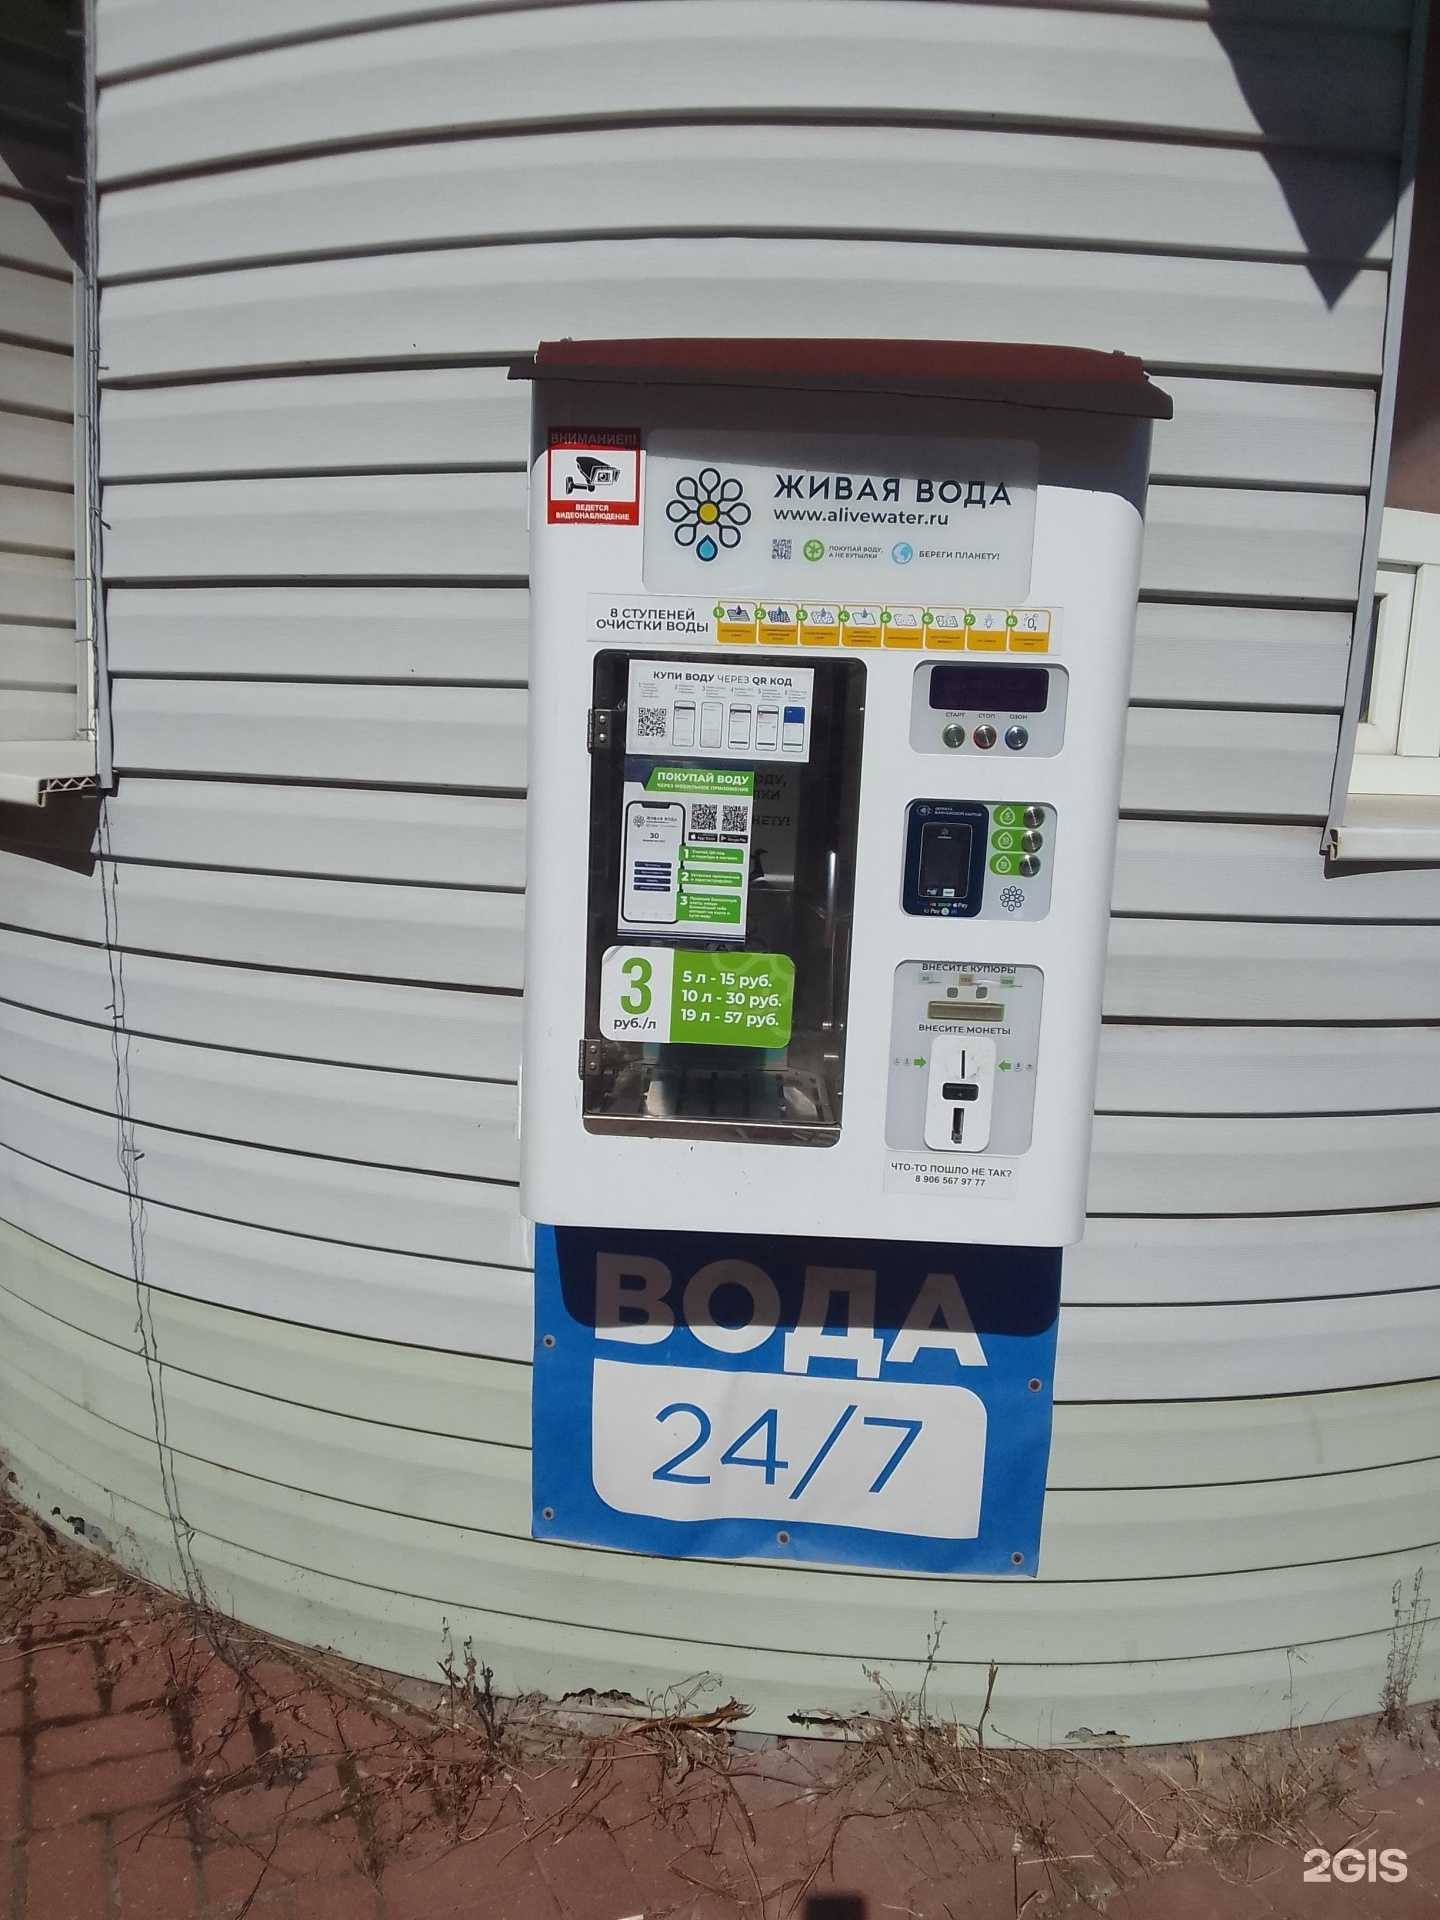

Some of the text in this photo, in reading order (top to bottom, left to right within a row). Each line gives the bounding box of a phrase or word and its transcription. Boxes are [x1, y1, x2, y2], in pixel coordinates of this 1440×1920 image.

[551, 432, 636, 445] ВНИМАНИЕ!!!
[773, 474, 1012, 508] ЖИВАЯ ВОДА
[575, 504, 609, 512] ВЕДЕТСЯ
[556, 512, 629, 520] ВИДЕОНАБЛЮДЕНИЕ
[773, 507, 949, 525] www.alivewater.ru
[829, 545, 862, 553] ПОКУПАЙ
[919, 550, 1000, 560] БЕРЕГИ ПЛАНЕТУ!
[610, 607, 695, 621] 8 СТУПЕНЕЙ
[596, 619, 662, 631] ОЧИСТКИ
[666, 621, 709, 634] ВОДЫ
[653, 671, 792, 687] КУПИ ВОДУ ЧЕРЕЗ QR КОД
[657, 772, 749, 786] ПОКУПАЙ ВОДУ
[684, 849, 689, 859] 1
[681, 871, 689, 882] 2
[679, 896, 688, 906] 3
[921, 963, 1017, 974] ВНЕСИТЕ КУПЮРЫ
[620, 957, 653, 1015] 3
[682, 970, 692, 983] 5
[695, 973, 706, 984] л
[720, 972, 735, 985] 15
[739, 973, 772, 989] руб.
[682, 989, 698, 1002] 10
[701, 992, 712, 1003] л
[726, 992, 745, 1005] 30
[749, 993, 782, 1009] руб.
[613, 1016, 657, 1030] руб./л
[681, 1008, 697, 1021] 19
[699, 1011, 711, 1022] л
[724, 1012, 743, 1024] 57
[746, 1012, 780, 1028] руб.
[918, 1024, 1011, 1035] ВНЕСИТЕ МОНЕТЫ
[890, 1162, 1013, 1178] ЧТО-ТО ПОШЛО НЕ ТАК?
[915, 1175, 986, 1187] 8 906 567 97 77
[594, 1251, 988, 1379] ВОДА
[652, 1403, 923, 1499] 24/7
